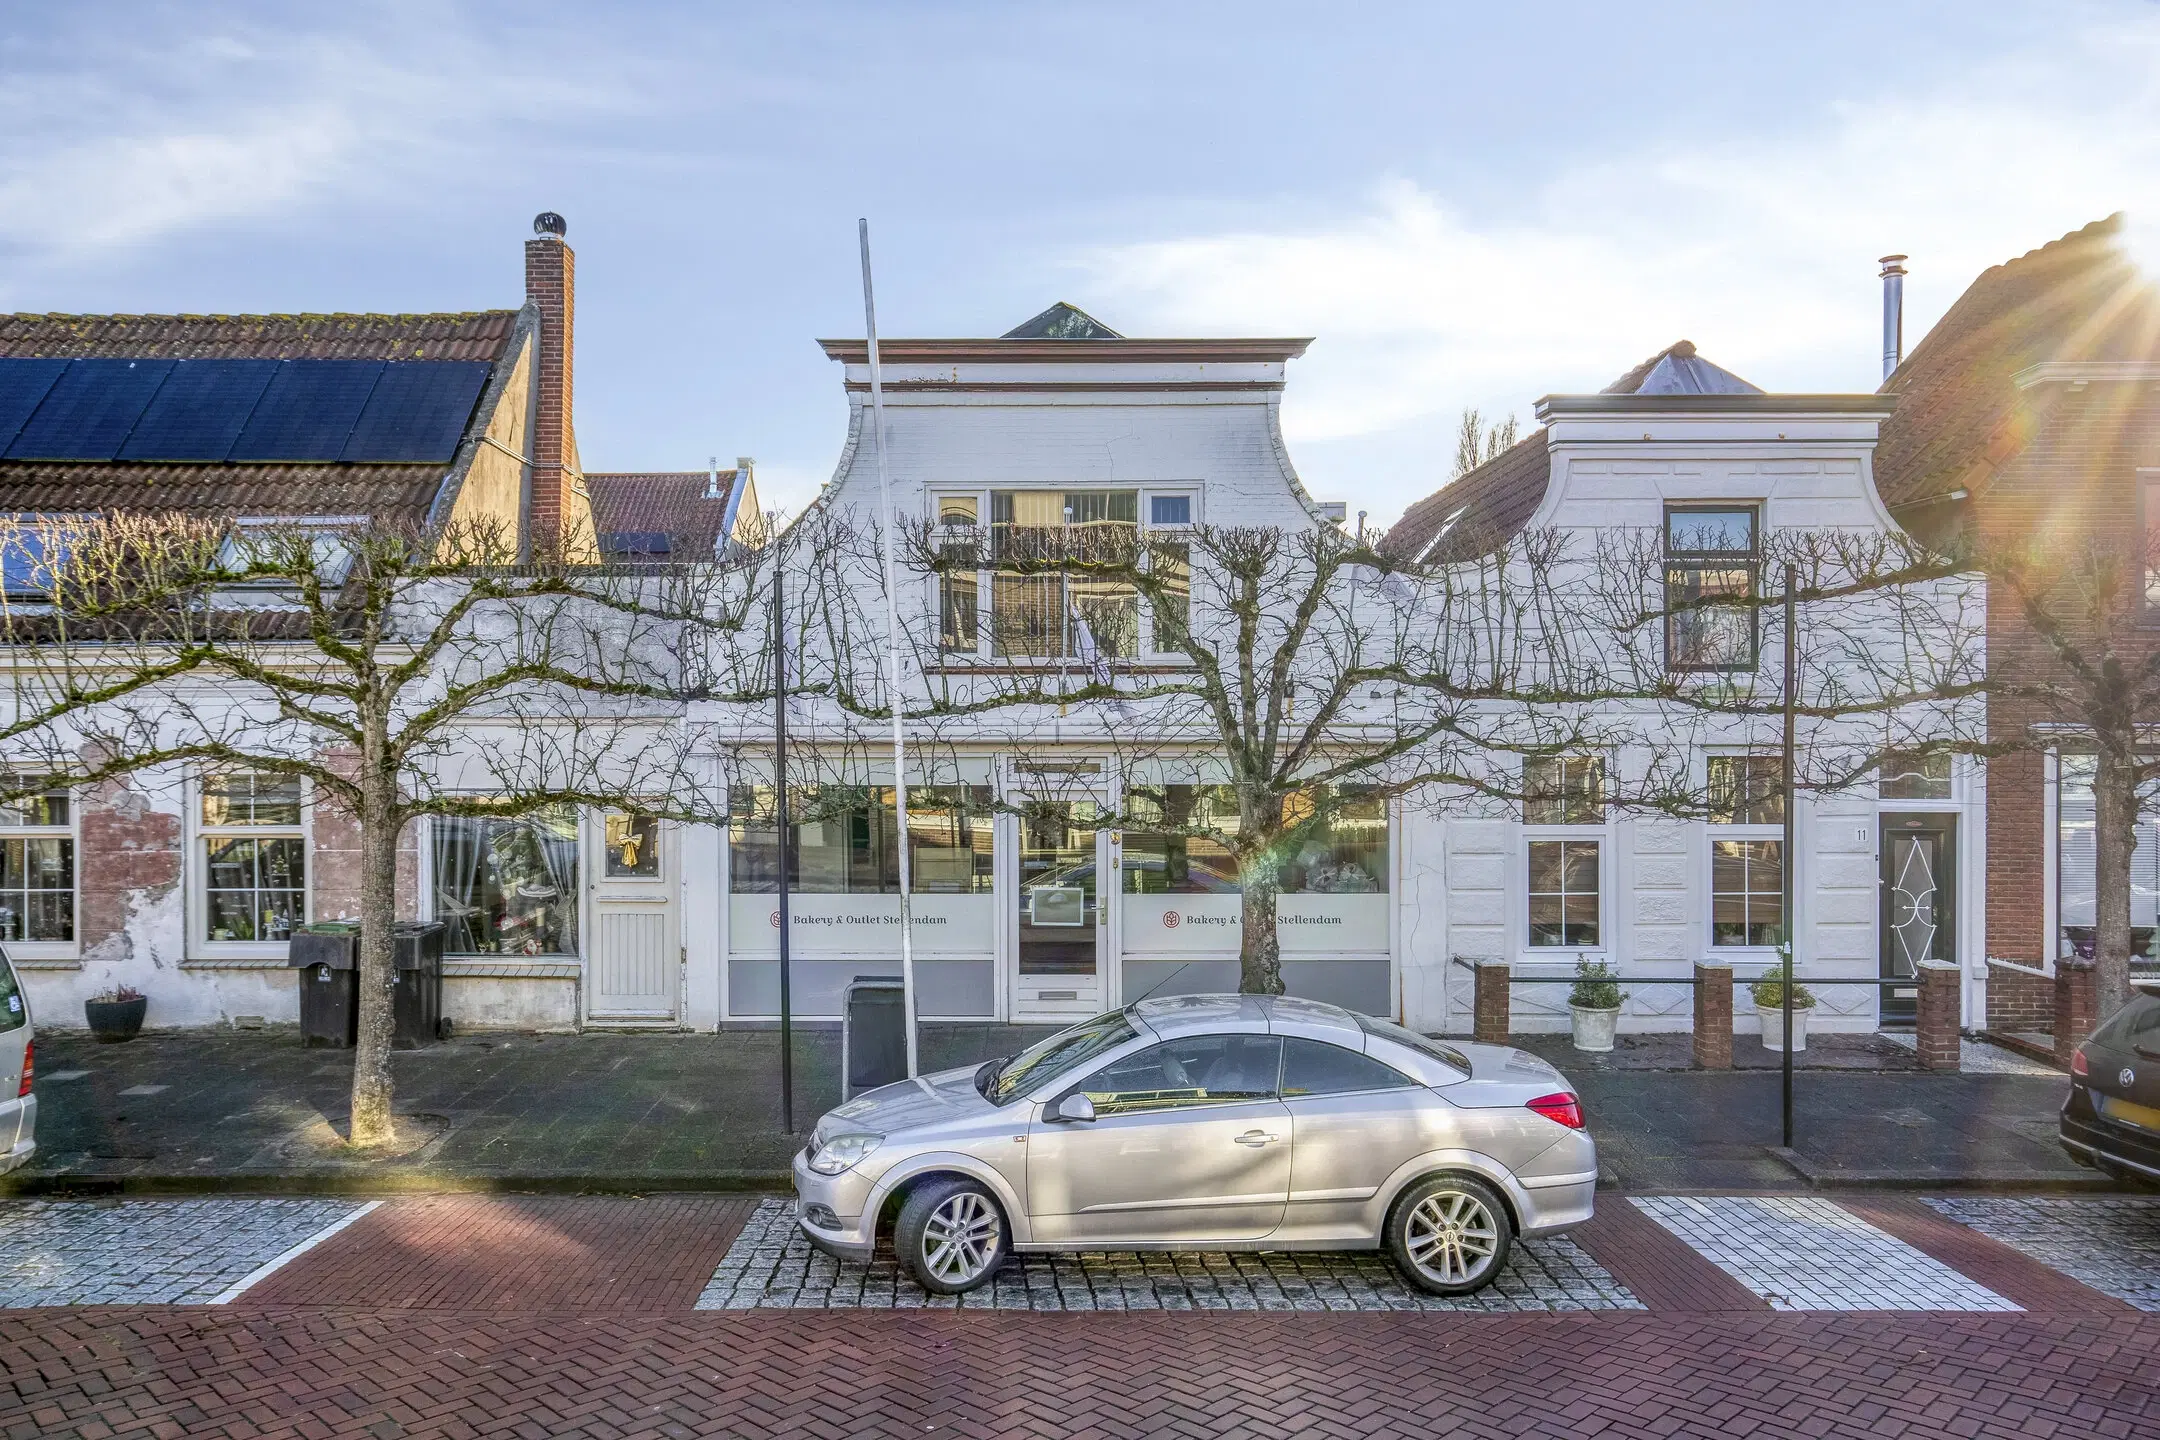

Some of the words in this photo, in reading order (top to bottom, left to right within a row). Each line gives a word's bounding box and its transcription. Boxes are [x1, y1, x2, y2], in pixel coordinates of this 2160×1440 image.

[1857, 829, 1866, 841] 11
[793, 915, 833, 927] Bakery
[836, 915, 843, 925] &
[846, 915, 880, 925] Outlet
[1186, 915, 1227, 927] Bakery
[1229, 915, 1237, 925] &
[1277, 915, 1342, 925] Stellendam
